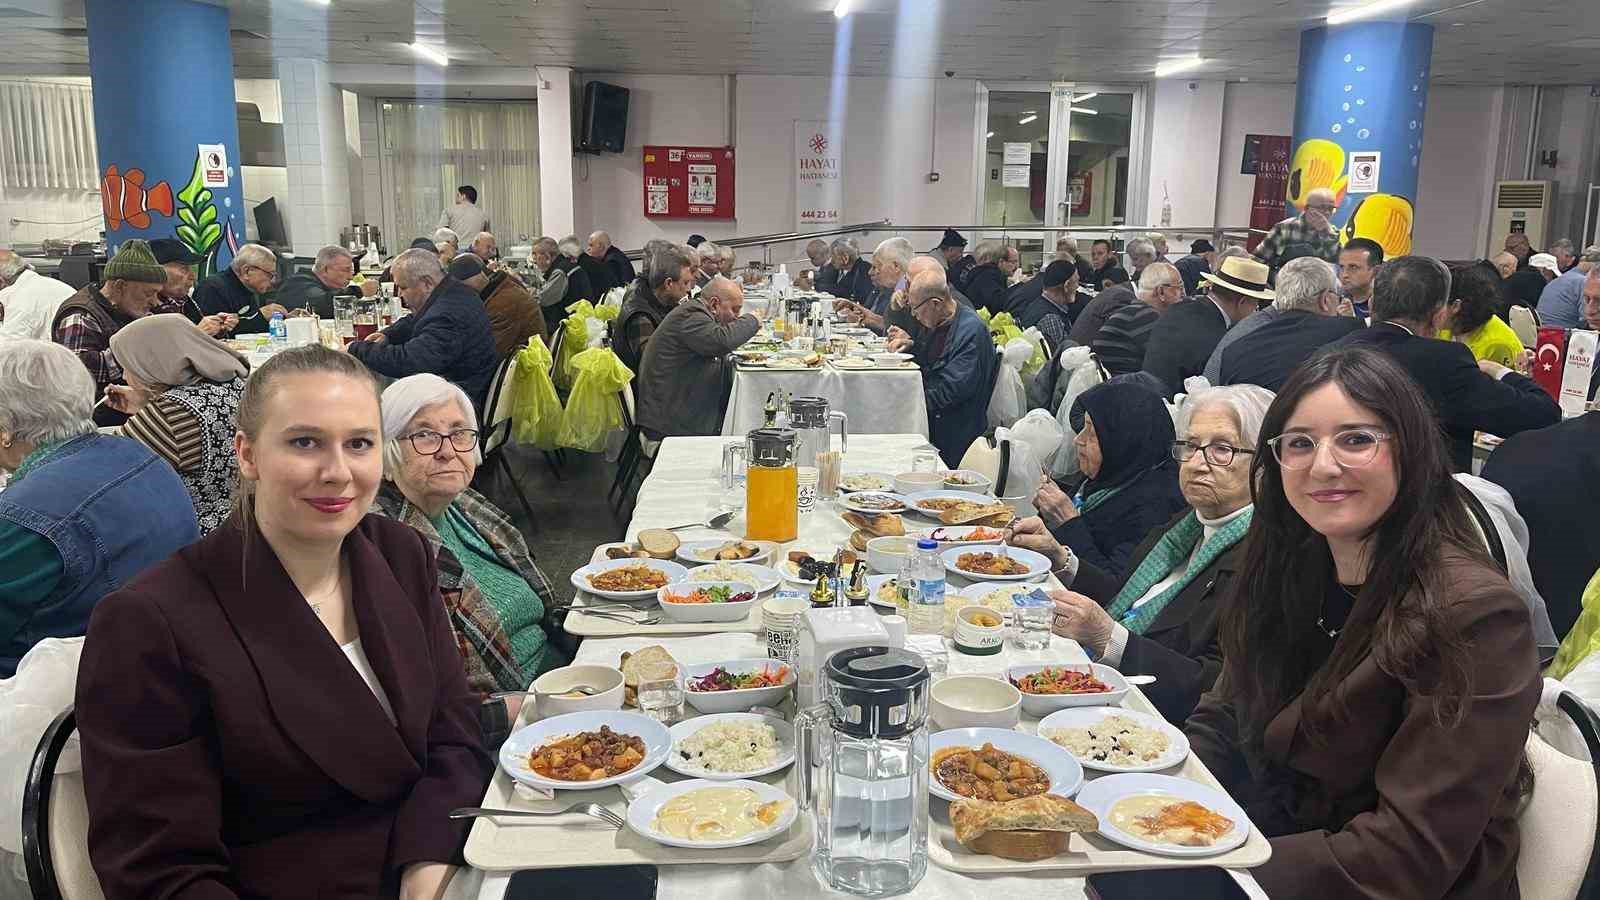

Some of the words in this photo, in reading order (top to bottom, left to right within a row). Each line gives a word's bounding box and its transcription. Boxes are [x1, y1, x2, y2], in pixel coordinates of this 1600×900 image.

[800, 158, 838, 169] HAYAT
[1260, 161, 1289, 172] HAYA
[801, 210, 815, 218] 444
